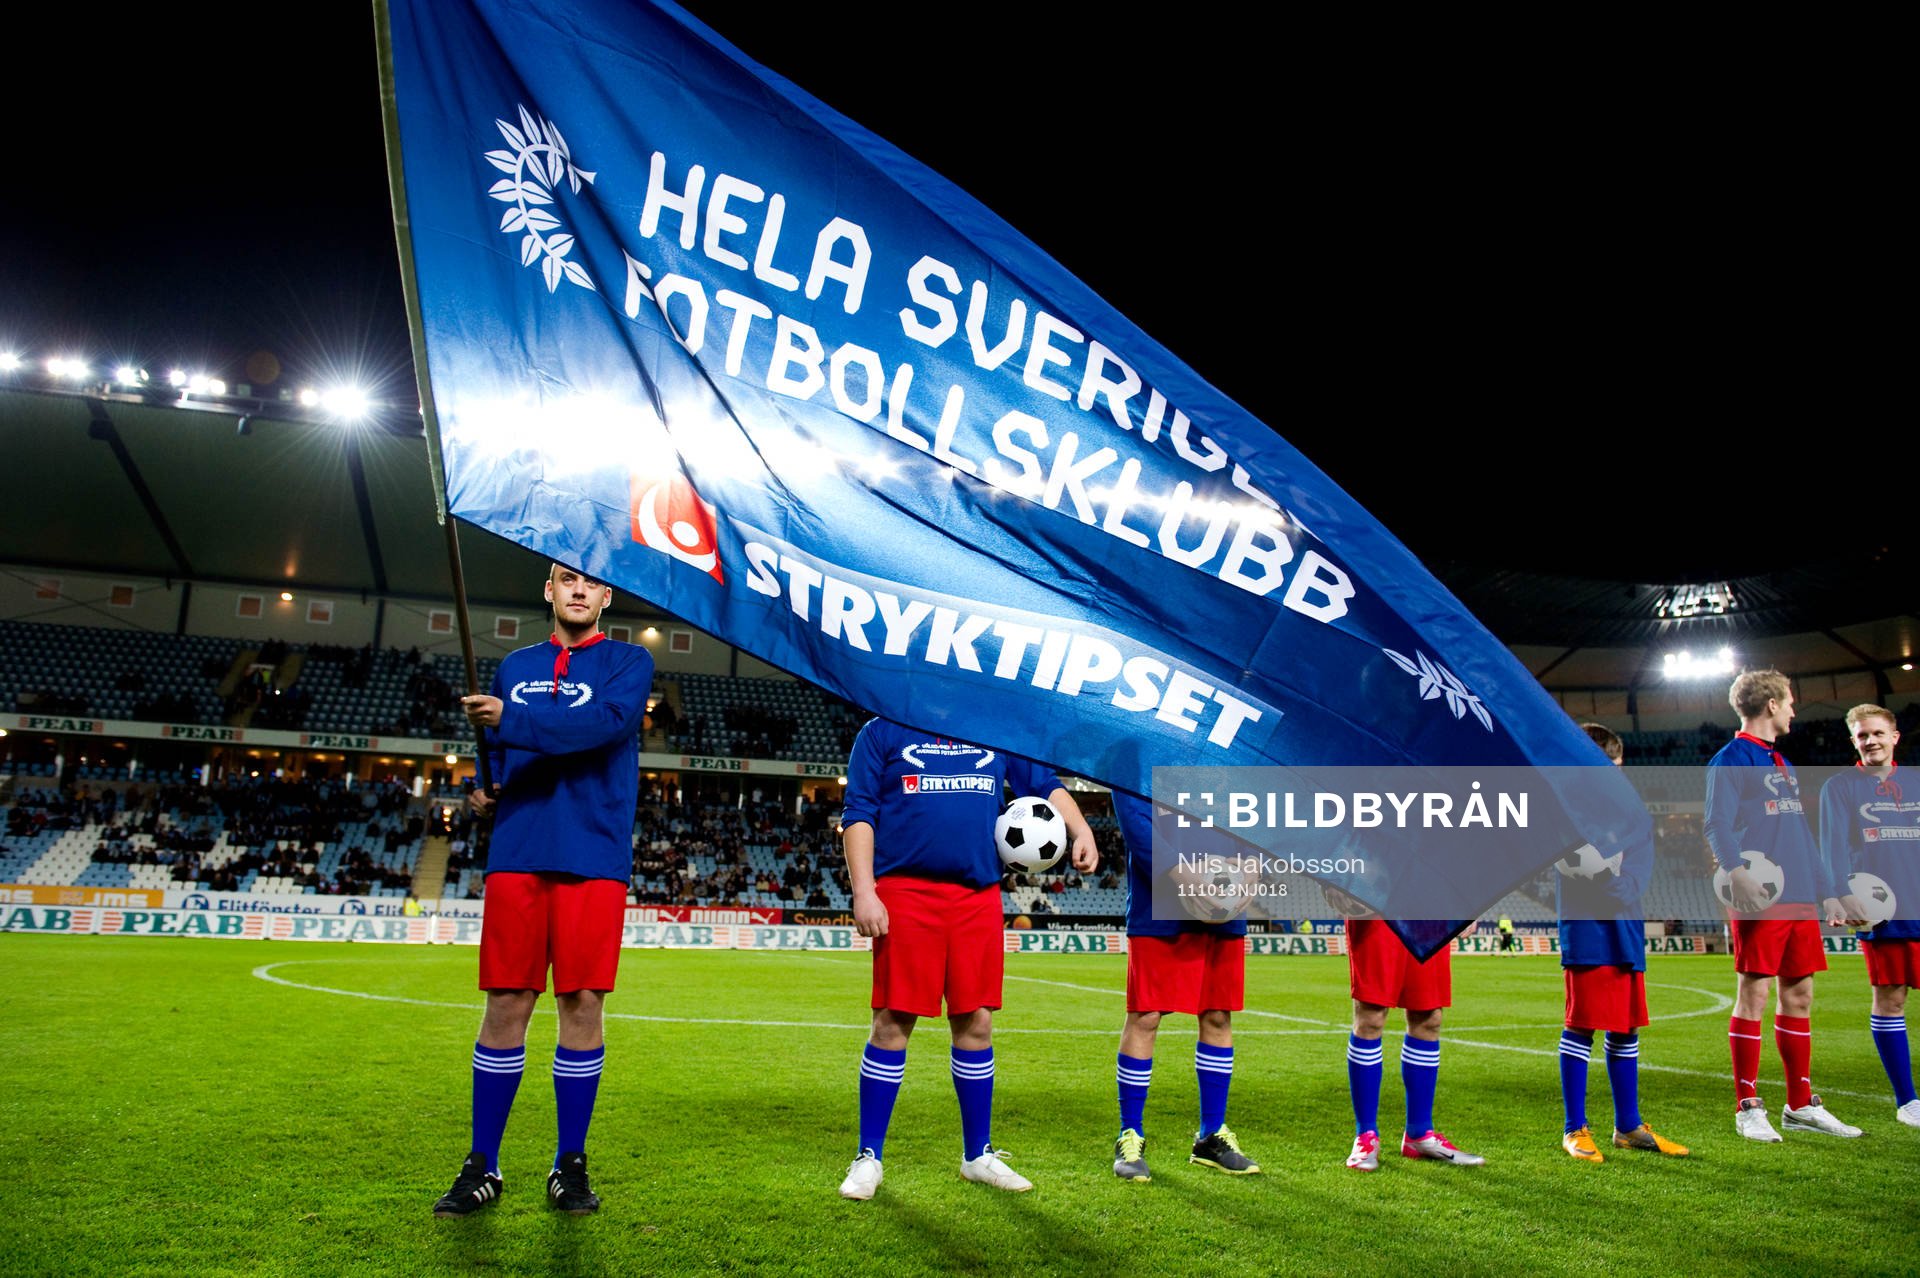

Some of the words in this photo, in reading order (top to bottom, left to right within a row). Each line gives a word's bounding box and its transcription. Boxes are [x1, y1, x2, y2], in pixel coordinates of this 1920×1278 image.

[638, 151, 872, 315] HELA
[899, 255, 1325, 545] SVERIG
[622, 247, 1356, 624] FOTBOLLSKLUBB
[745, 540, 1263, 749] STRYKTIPSET
[28, 716, 93, 732] PEAB
[170, 726, 235, 741] PEAB
[308, 734, 370, 749] PEAB
[441, 742, 478, 755] PEA
[688, 757, 742, 771] PEAB
[921, 777, 993, 791] STRYKTIPSET
[0, 908, 71, 930] AB
[118, 911, 244, 935] PEAB
[793, 912, 856, 926] Swedb
[291, 917, 408, 941] PEAB
[754, 928, 852, 949] PEAB
[1019, 933, 1107, 952] PEAB
[1250, 937, 1328, 953] PEAB
[1823, 937, 1857, 952] AB
